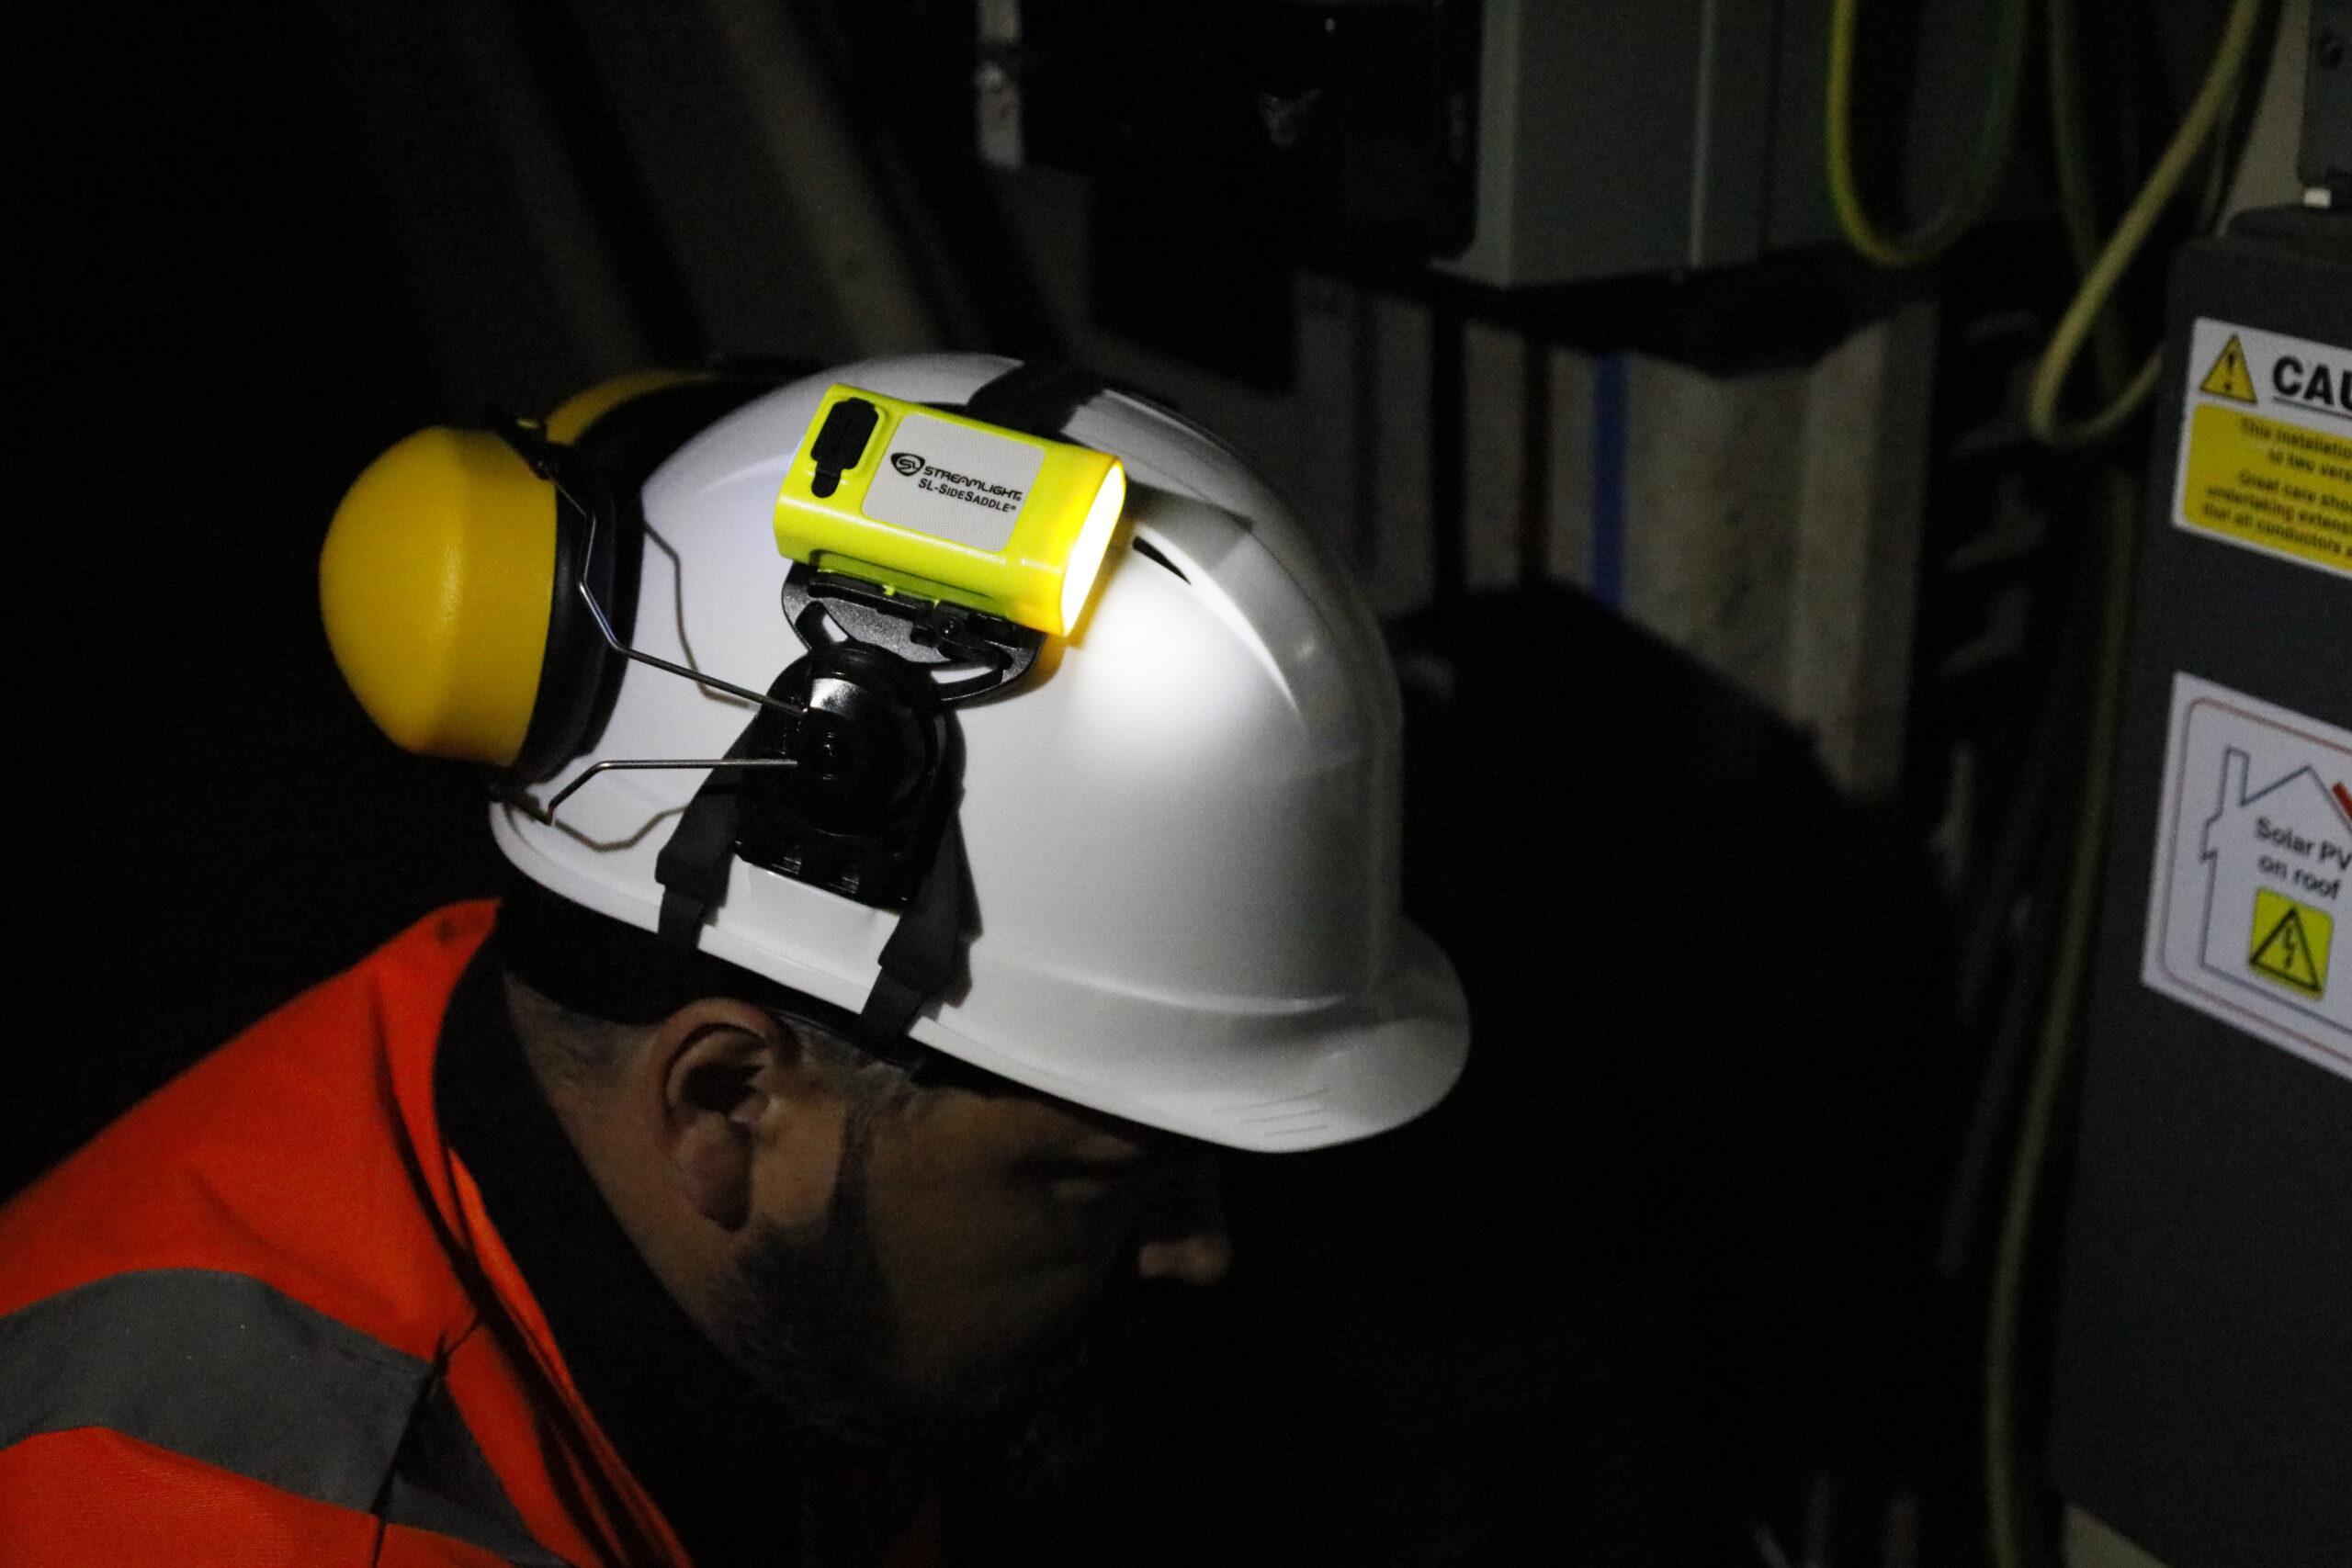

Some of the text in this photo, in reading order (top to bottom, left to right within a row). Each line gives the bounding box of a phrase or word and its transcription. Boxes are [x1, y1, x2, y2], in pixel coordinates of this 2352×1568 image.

[923, 466, 1023, 500] STREAMLIGHT
[2256, 816, 2352, 870] Solar PV
[2259, 855, 2342, 900] on roof
